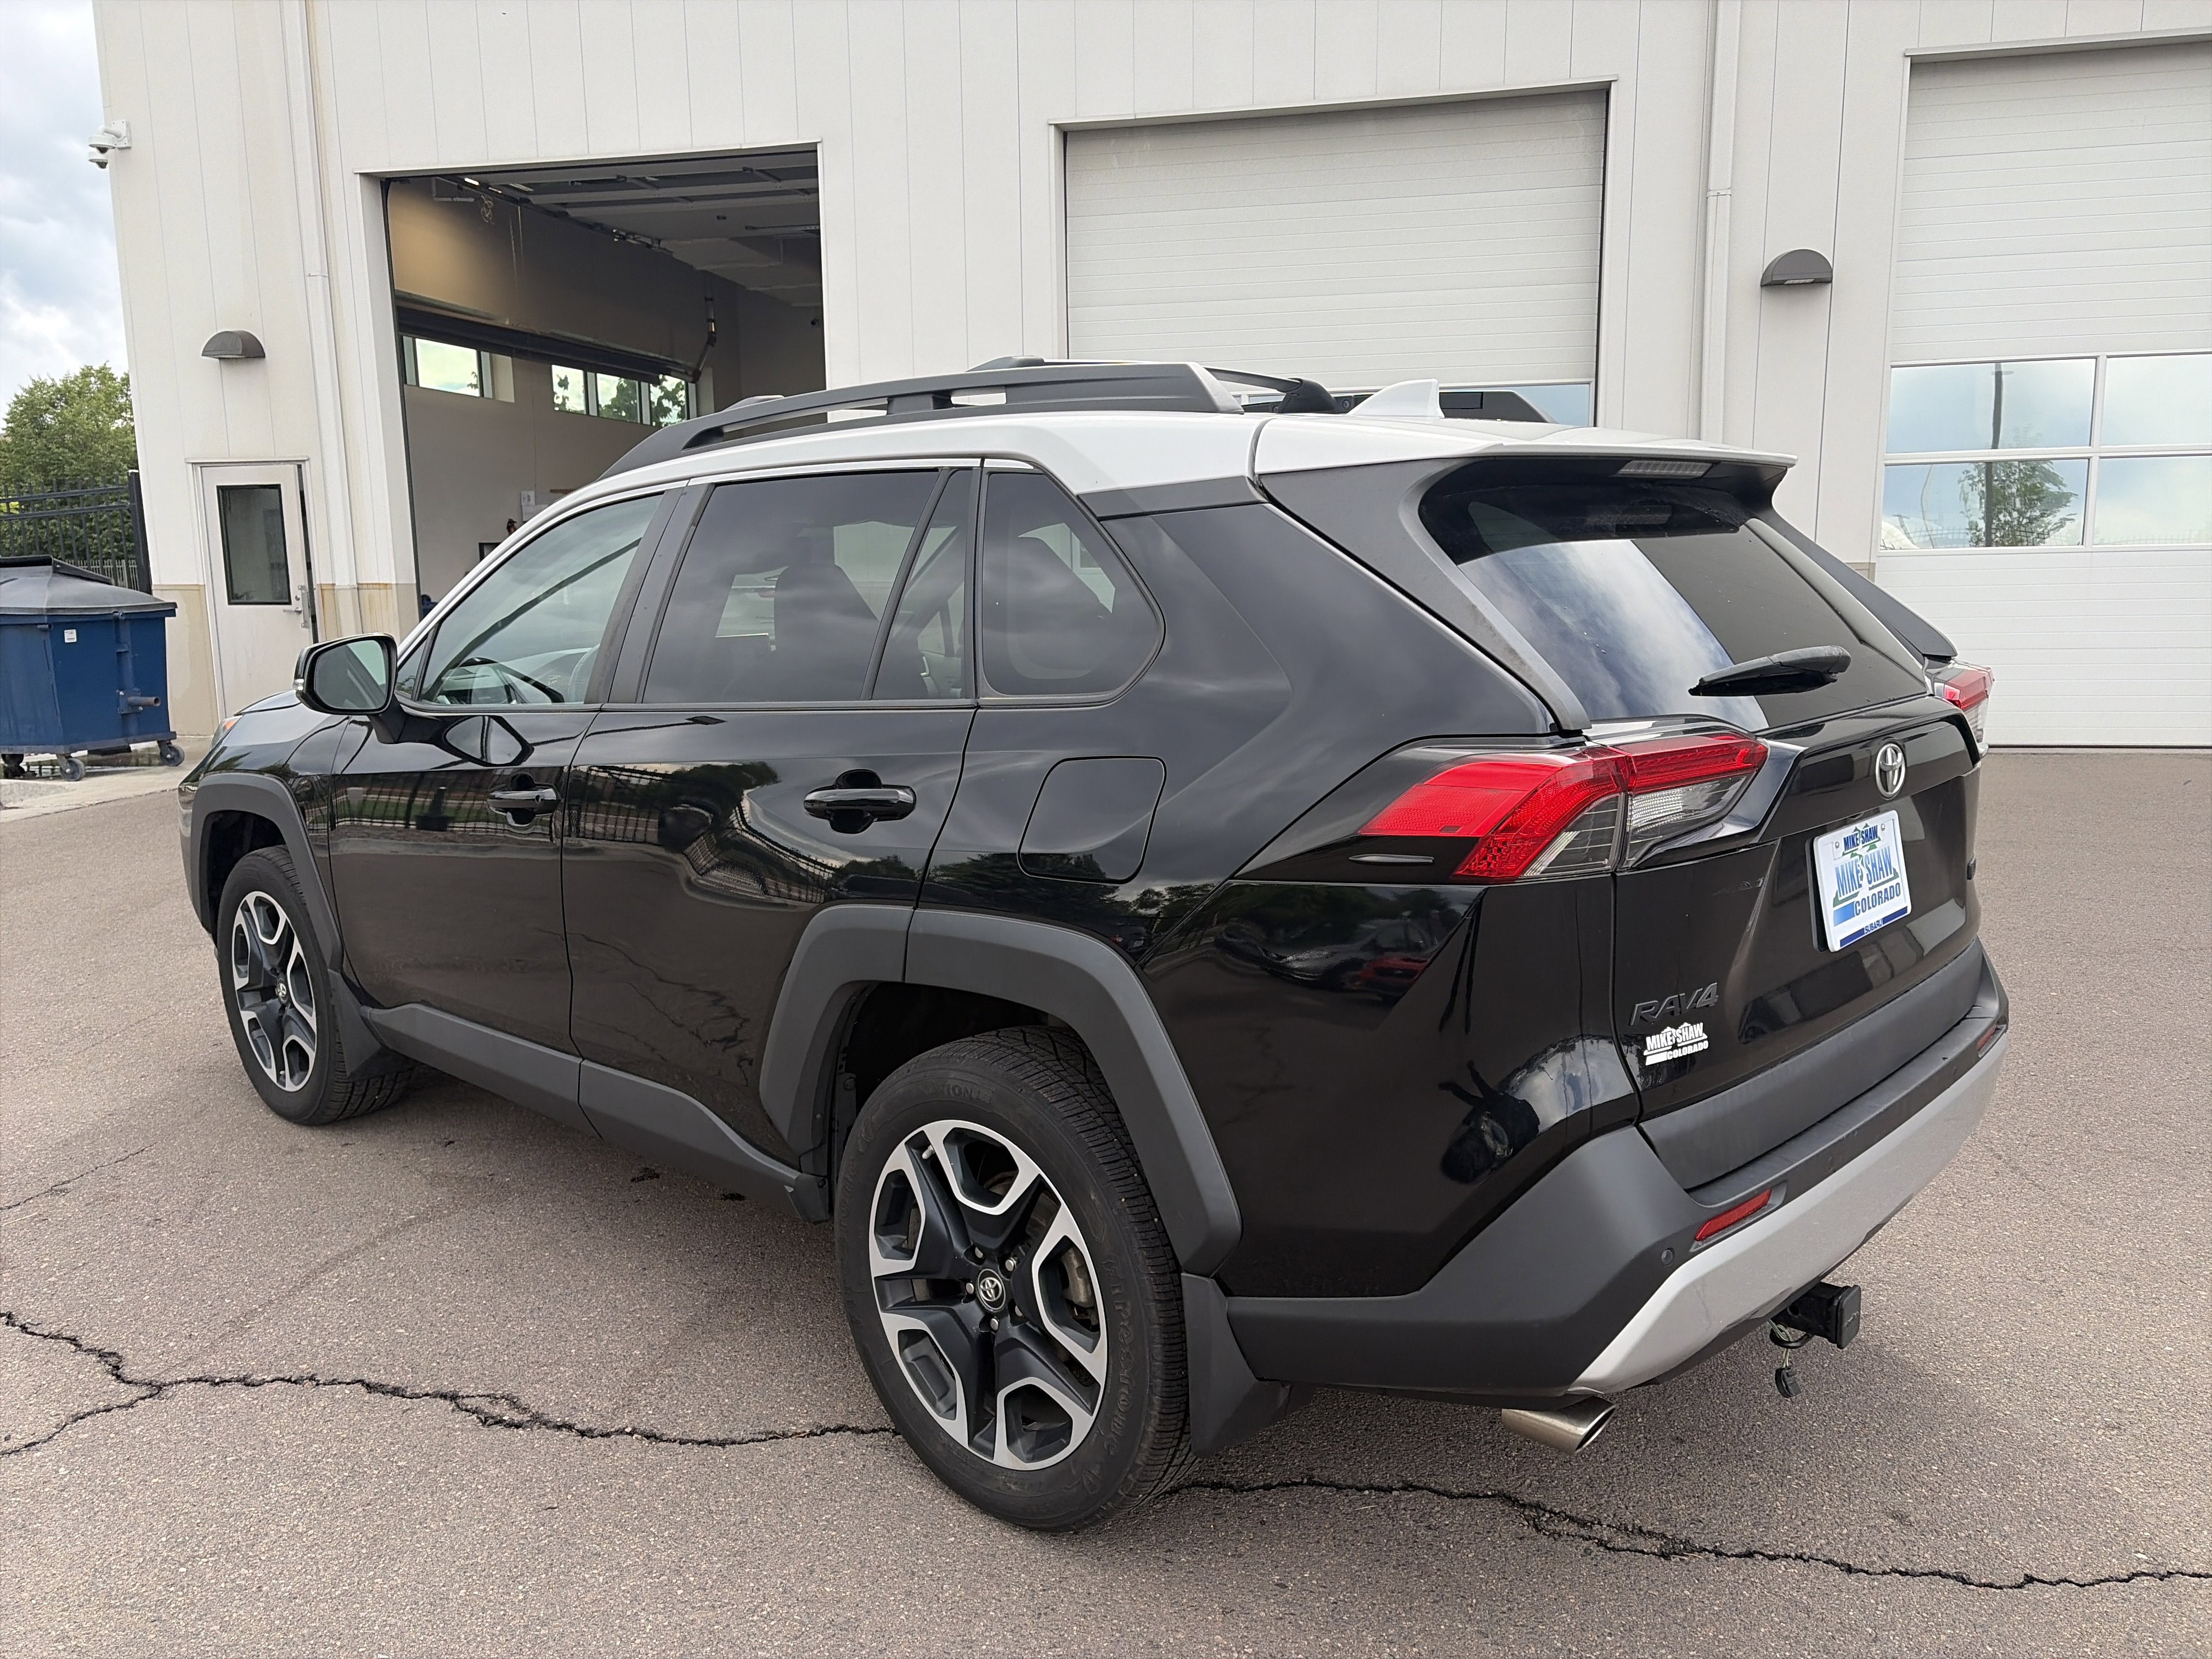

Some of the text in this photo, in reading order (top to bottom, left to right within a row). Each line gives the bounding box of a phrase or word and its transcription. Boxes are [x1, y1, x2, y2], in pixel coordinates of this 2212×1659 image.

[1843, 825, 1878, 851] MIKE SHAW
[1835, 845, 1893, 898] MIKE SHAW
[1854, 882, 1901, 916] COLORADO
[1865, 918, 1883, 934] SUBARU
[1628, 982, 1719, 1026] RAV4
[1646, 1022, 1703, 1051] MIKE SHAW
[1667, 1040, 1709, 1060] COLORADO
